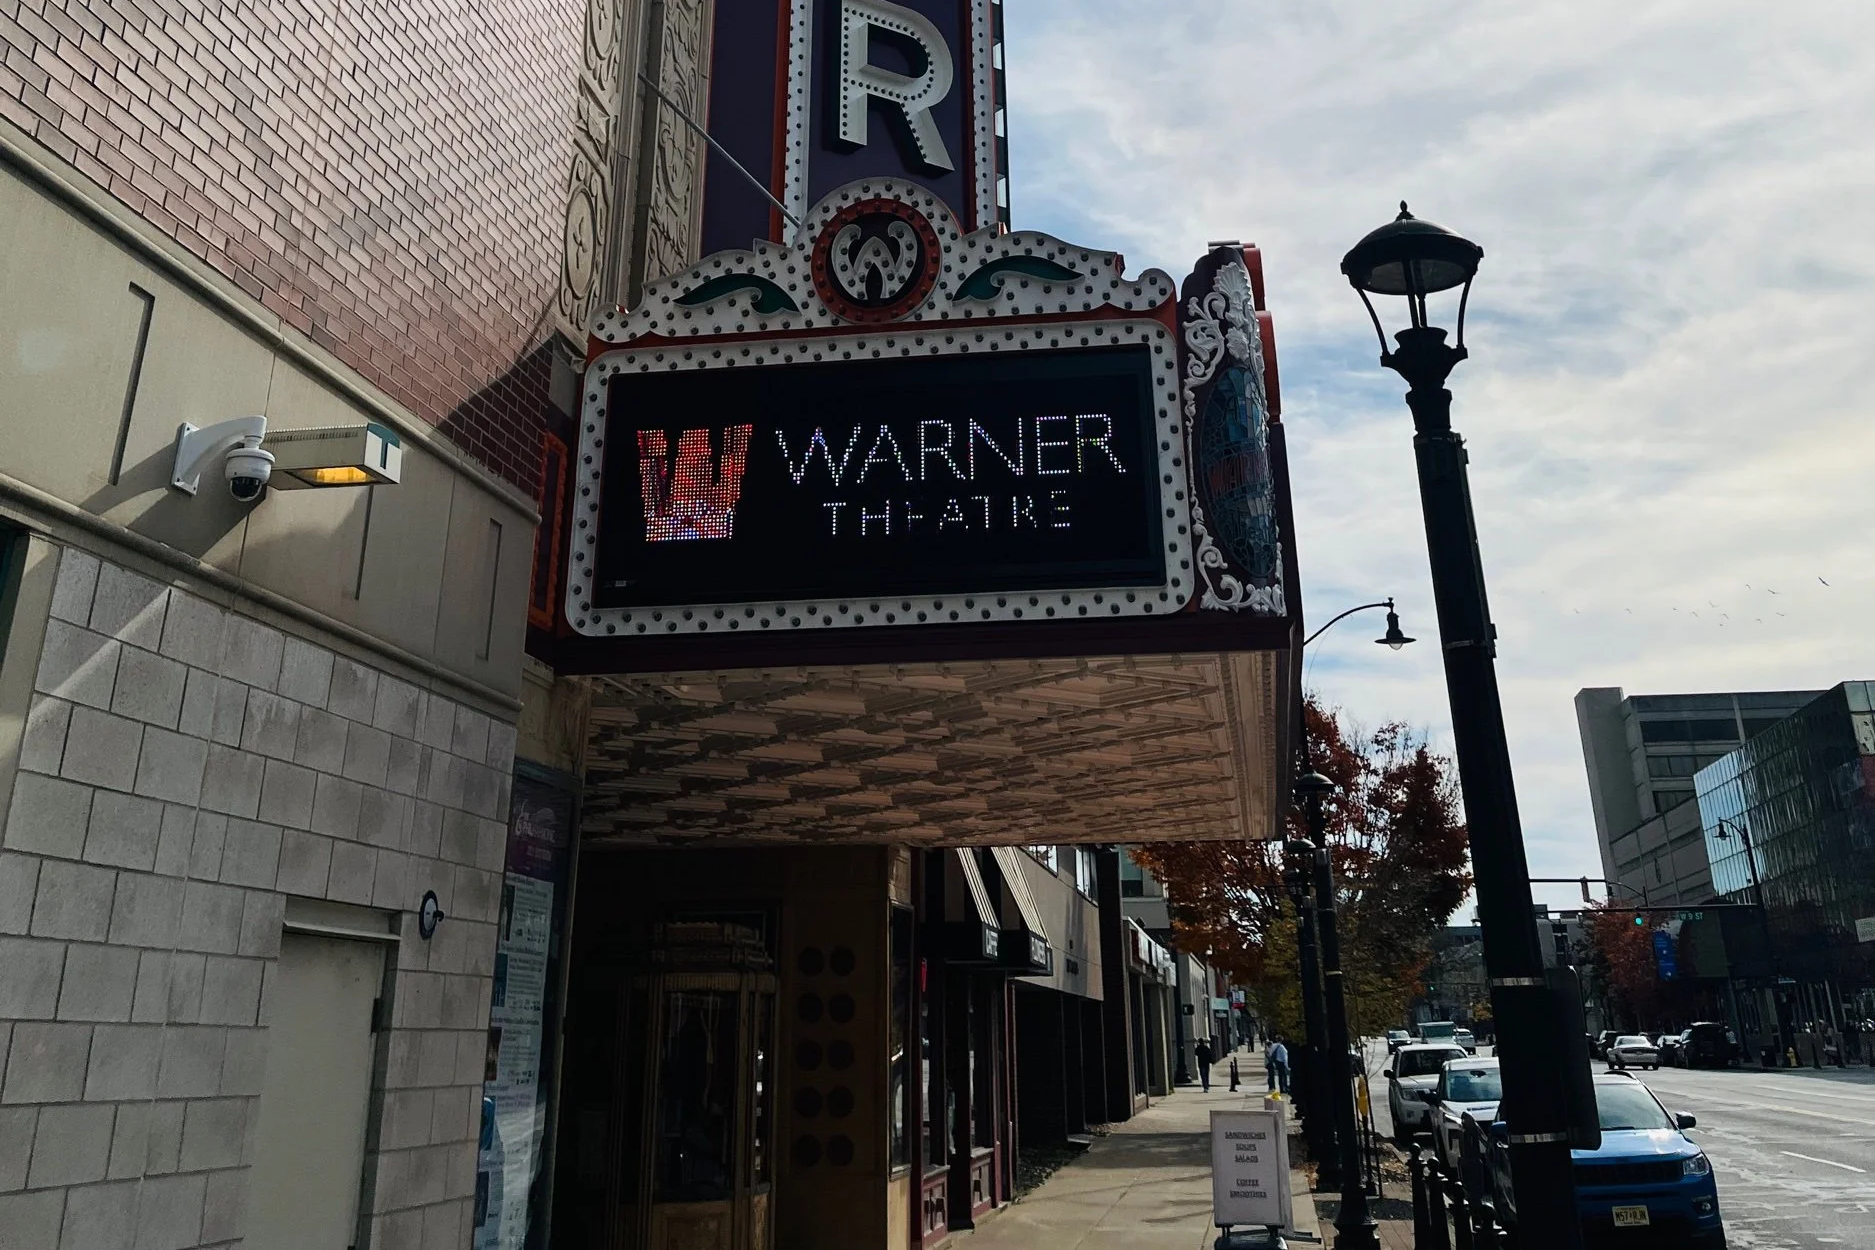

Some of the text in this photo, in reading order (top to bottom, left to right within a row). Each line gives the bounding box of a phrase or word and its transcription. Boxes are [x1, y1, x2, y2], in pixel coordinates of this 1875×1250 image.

[774, 412, 1126, 487] WARNER
[1695, 912, 1702, 920] ST
[1225, 1131, 1266, 1139] SANDWICHES
[1235, 1143, 1257, 1151] SOUPS
[1230, 1190, 1267, 1198] SMOOTHIES
